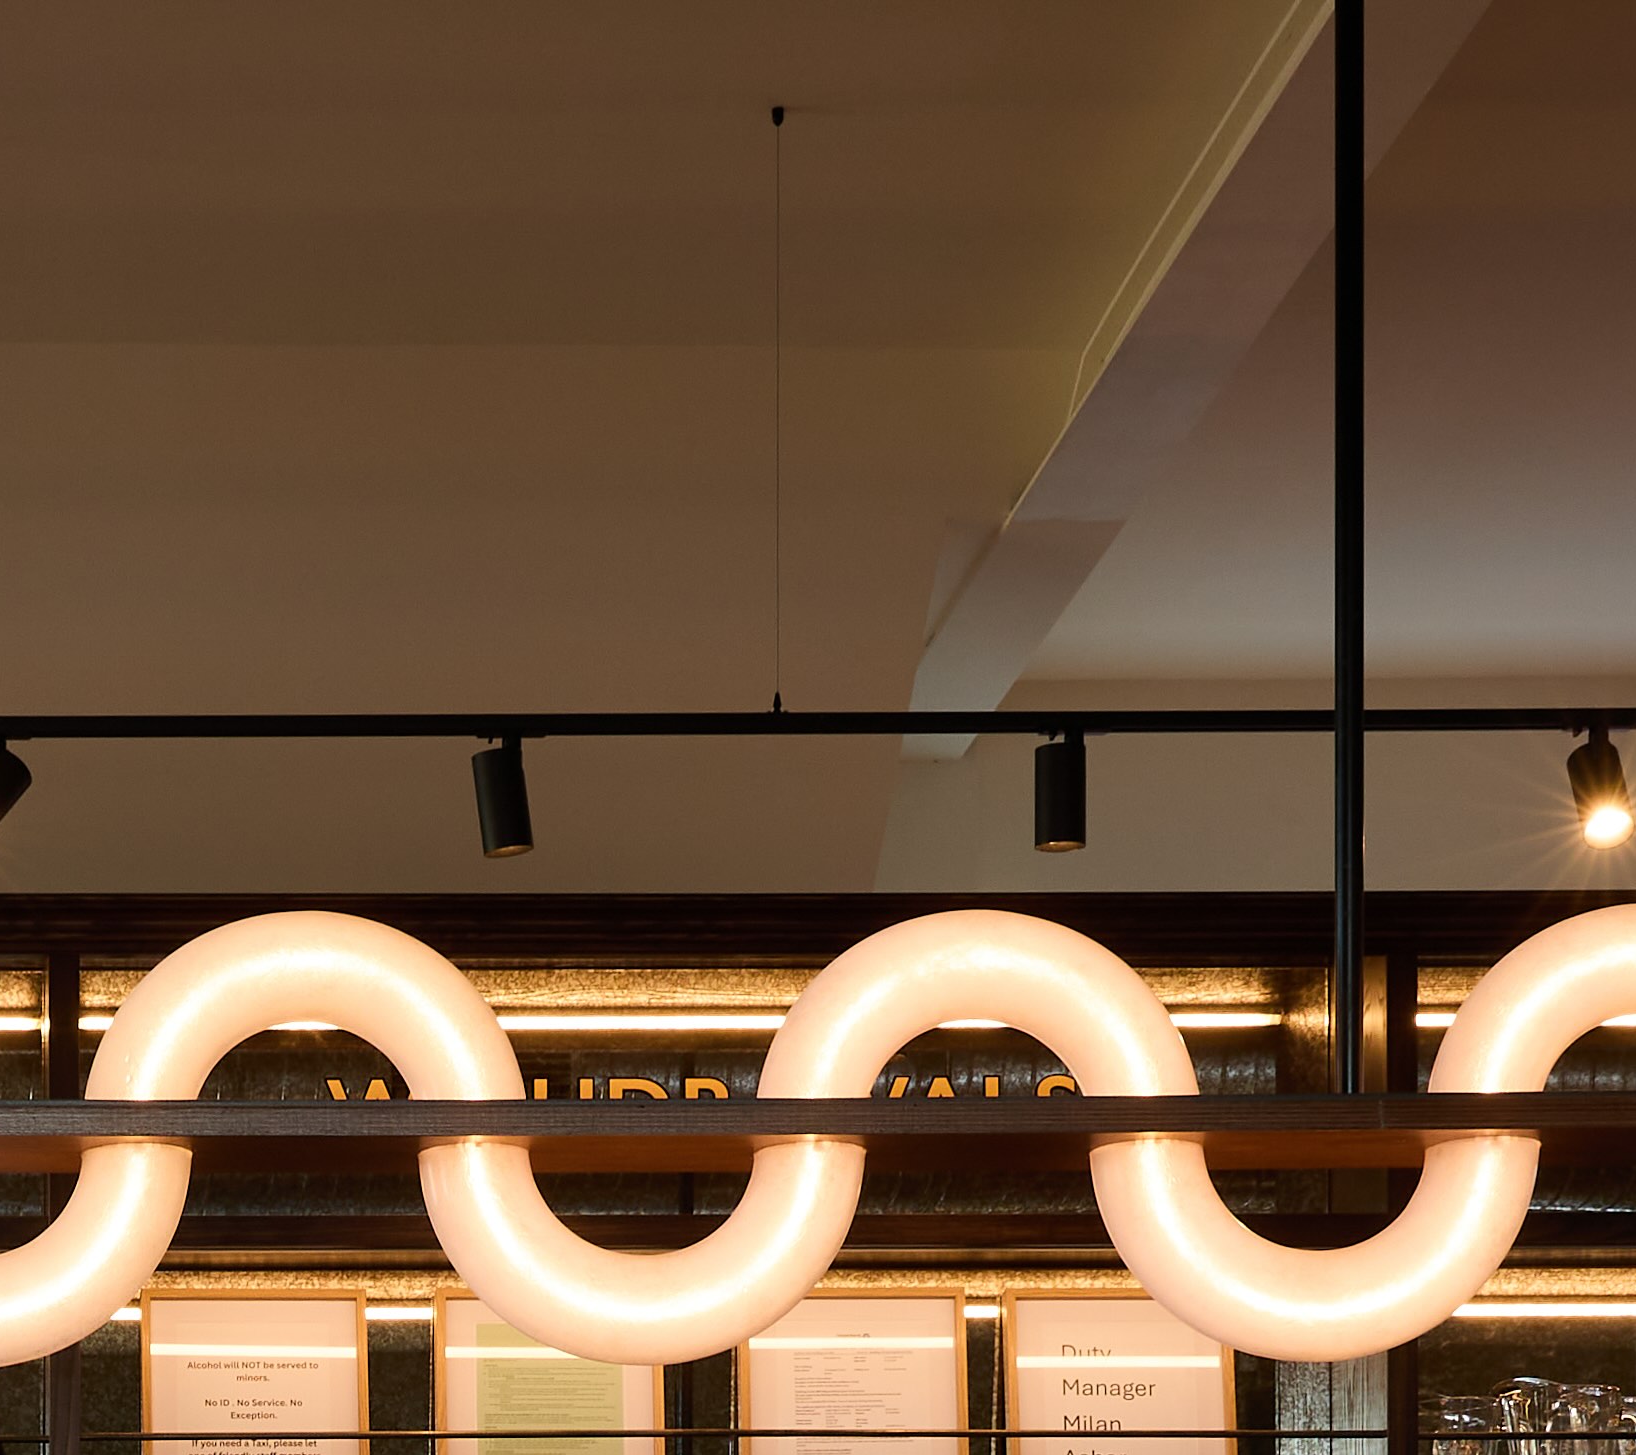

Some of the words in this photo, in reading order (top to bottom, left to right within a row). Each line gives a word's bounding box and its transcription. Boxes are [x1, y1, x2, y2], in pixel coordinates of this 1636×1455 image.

[187, 1362, 221, 1370] Alcohol
[236, 1374, 270, 1382] minors.
[1063, 1379, 1156, 1401] Manager
[230, 1412, 277, 1420] Exception.
[1064, 1415, 1121, 1431] Milan
[200, 1441, 217, 1449] you
[274, 1440, 303, 1449] please
